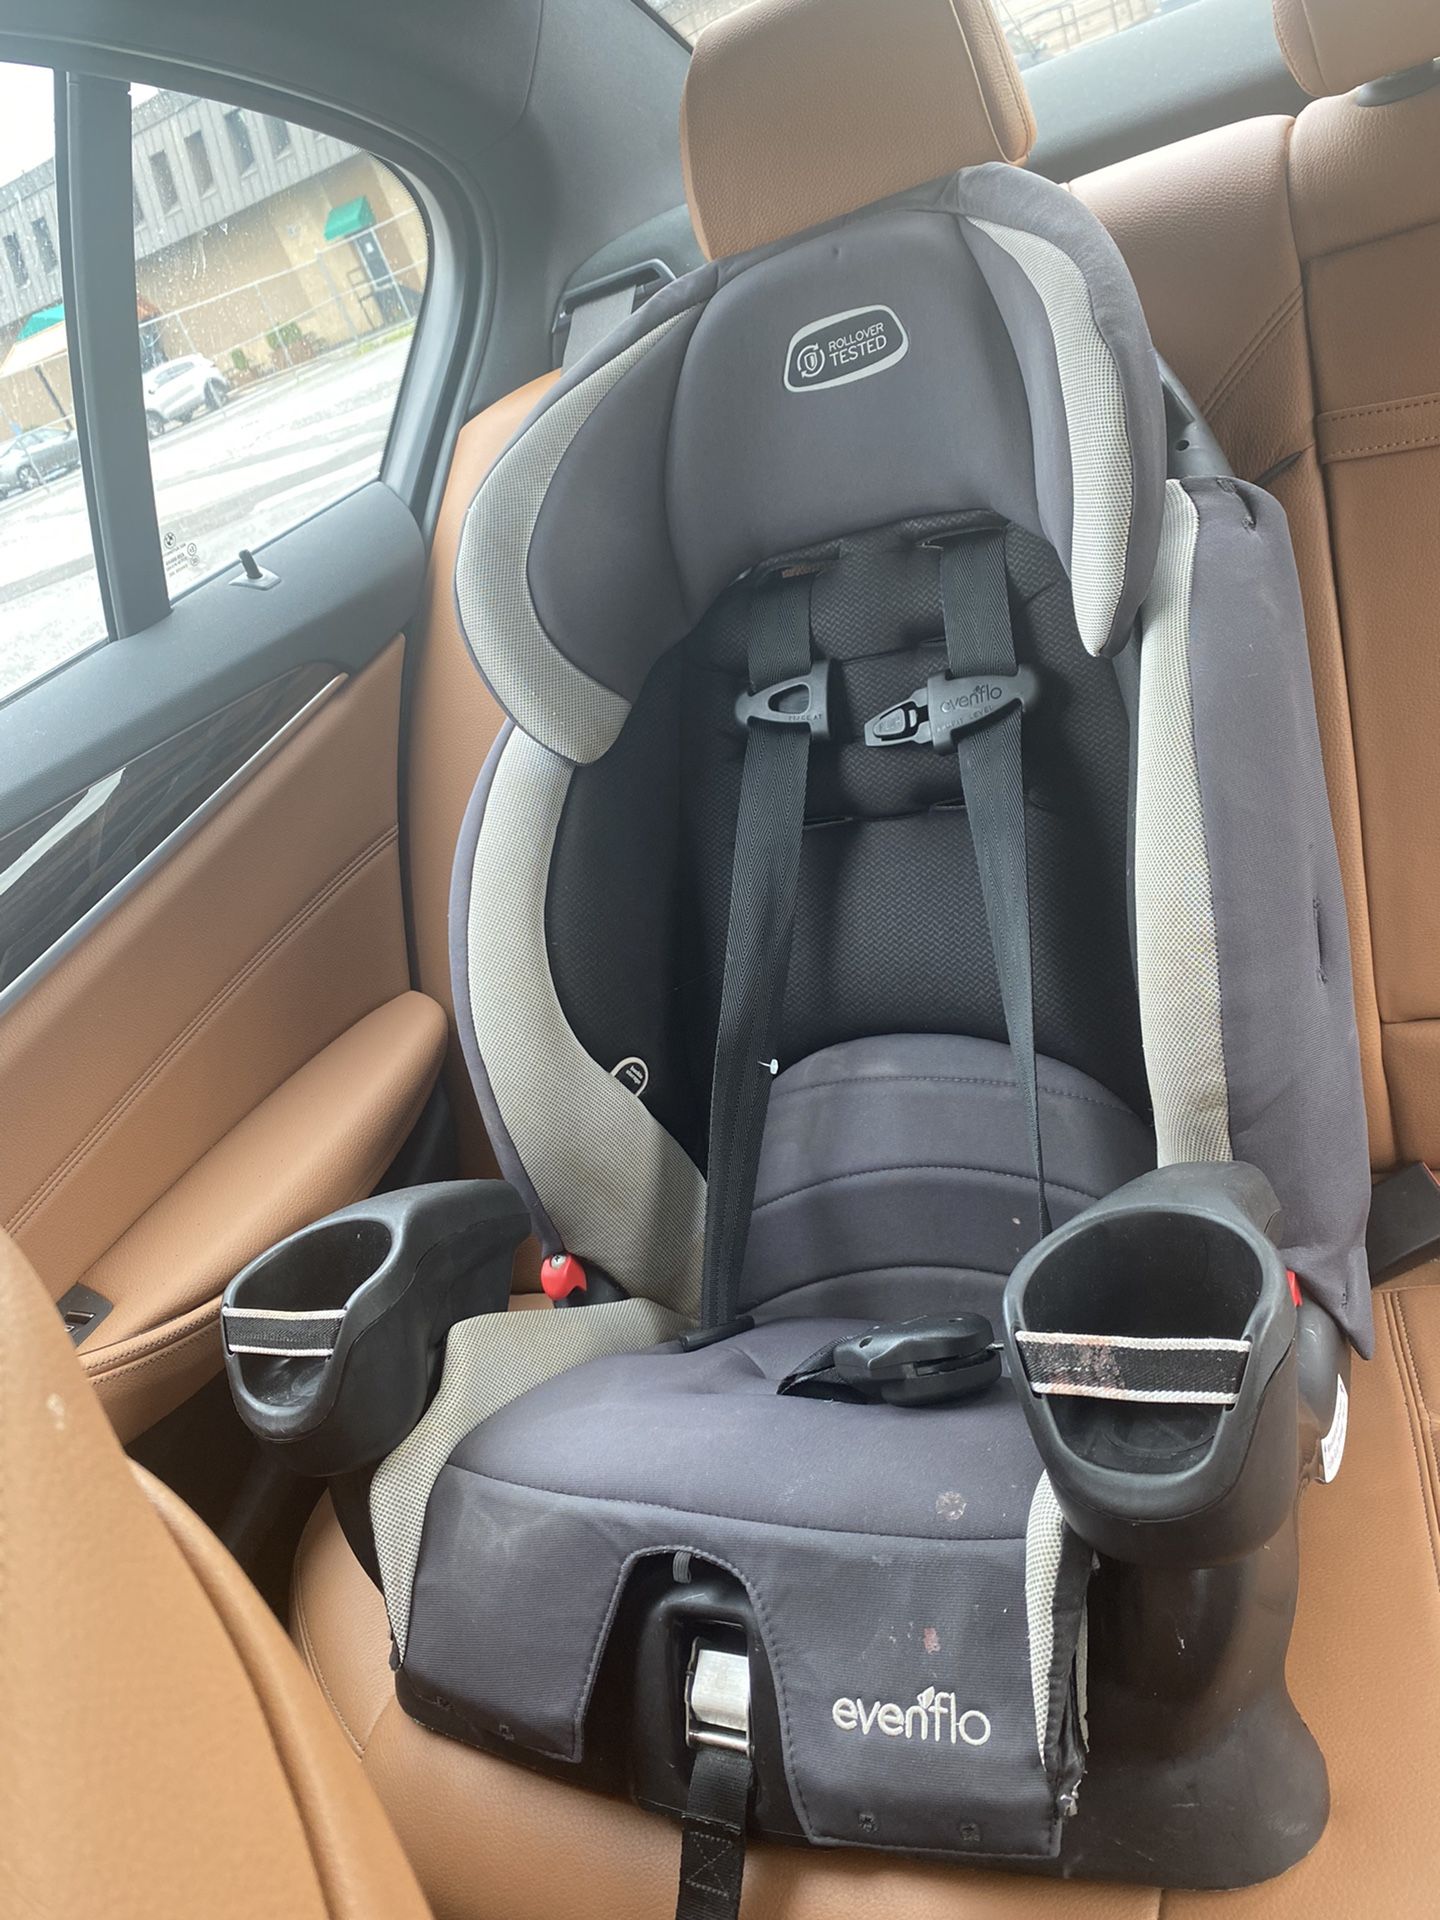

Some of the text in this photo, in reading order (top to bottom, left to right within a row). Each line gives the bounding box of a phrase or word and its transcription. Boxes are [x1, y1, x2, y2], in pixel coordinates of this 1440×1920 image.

[828, 322, 885, 352] ROLLOVER
[829, 334, 888, 367] TESTED
[940, 684, 1003, 713] evenflo
[831, 1686, 992, 1746] evenflo
